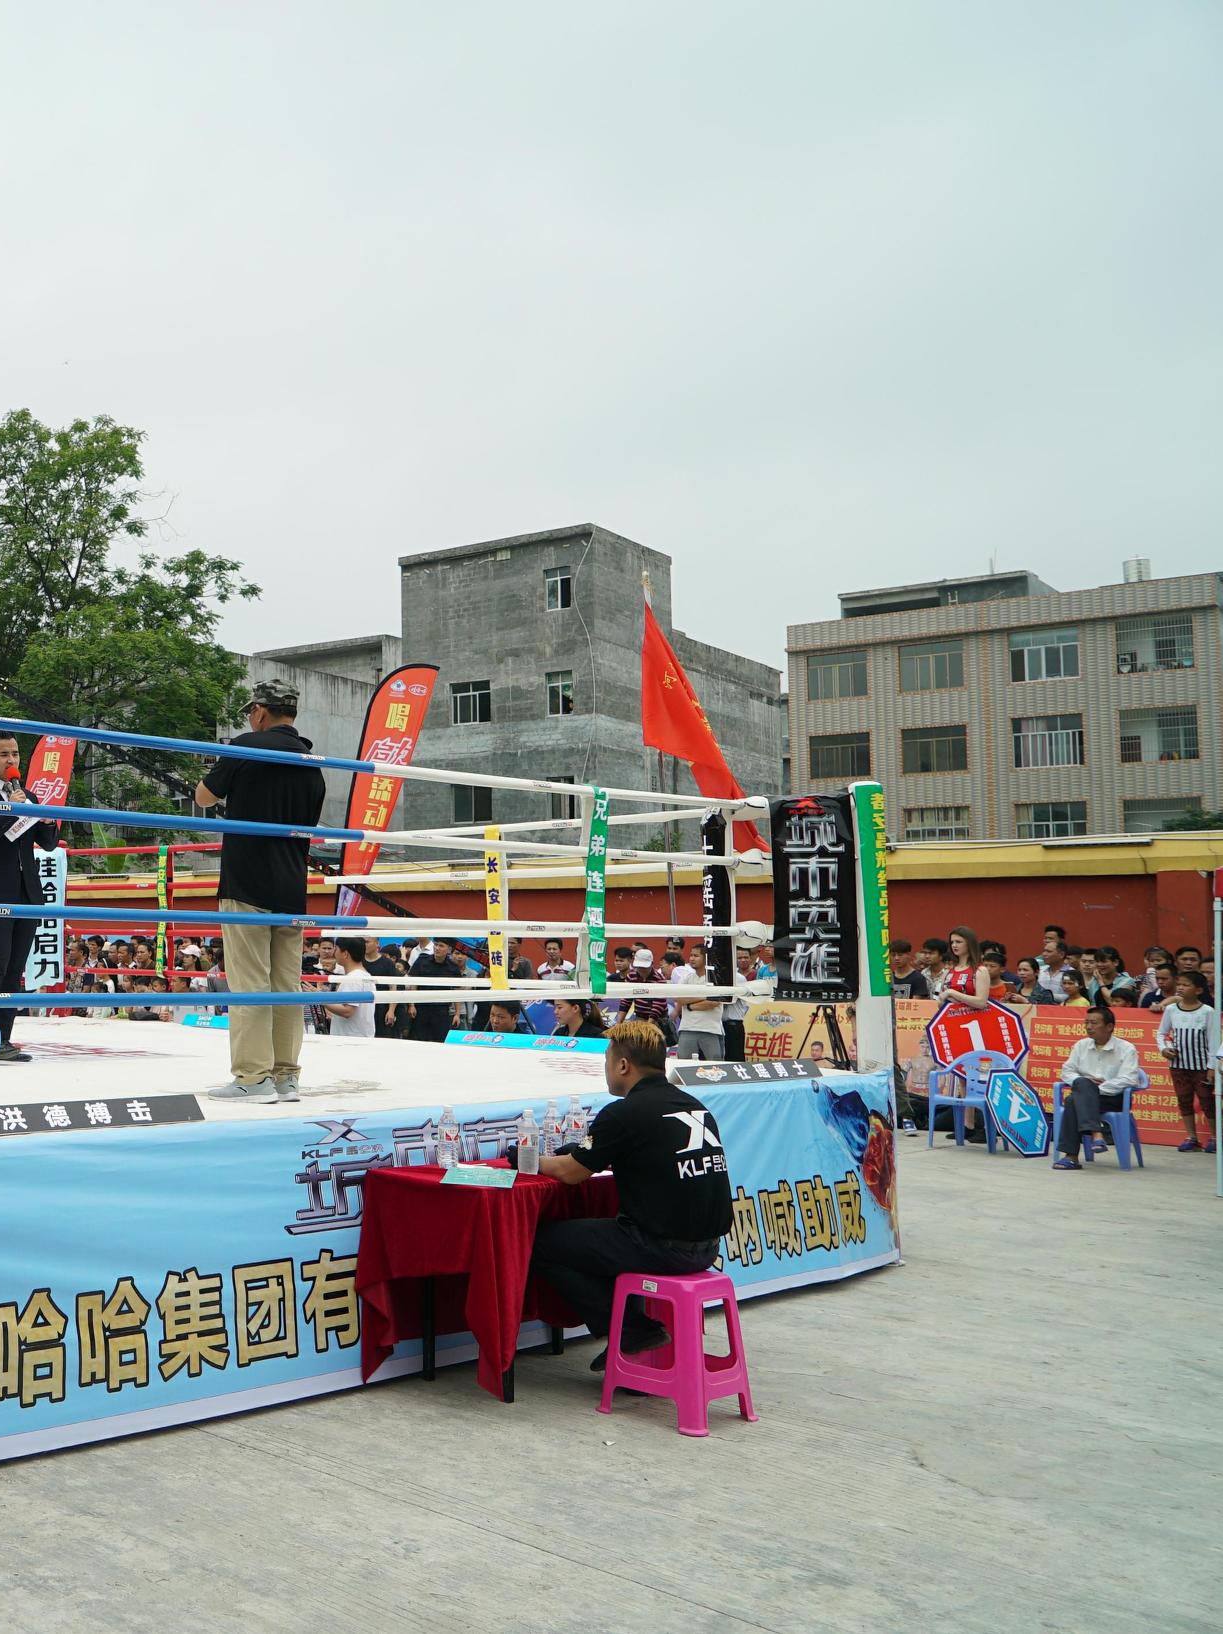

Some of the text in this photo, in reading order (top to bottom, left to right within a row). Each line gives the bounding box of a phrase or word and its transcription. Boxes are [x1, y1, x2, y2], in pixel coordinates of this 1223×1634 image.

[385, 703, 411, 732] 喝
[587, 790, 608, 962] 兄弟连酒吧
[487, 856, 503, 967] 长安砖
[783, 814, 845, 984] 城市英雄
[744, 1032, 793, 1058] 英雄
[960, 1019, 986, 1051] 1
[732, 1061, 808, 1080] 壮瑶勇士
